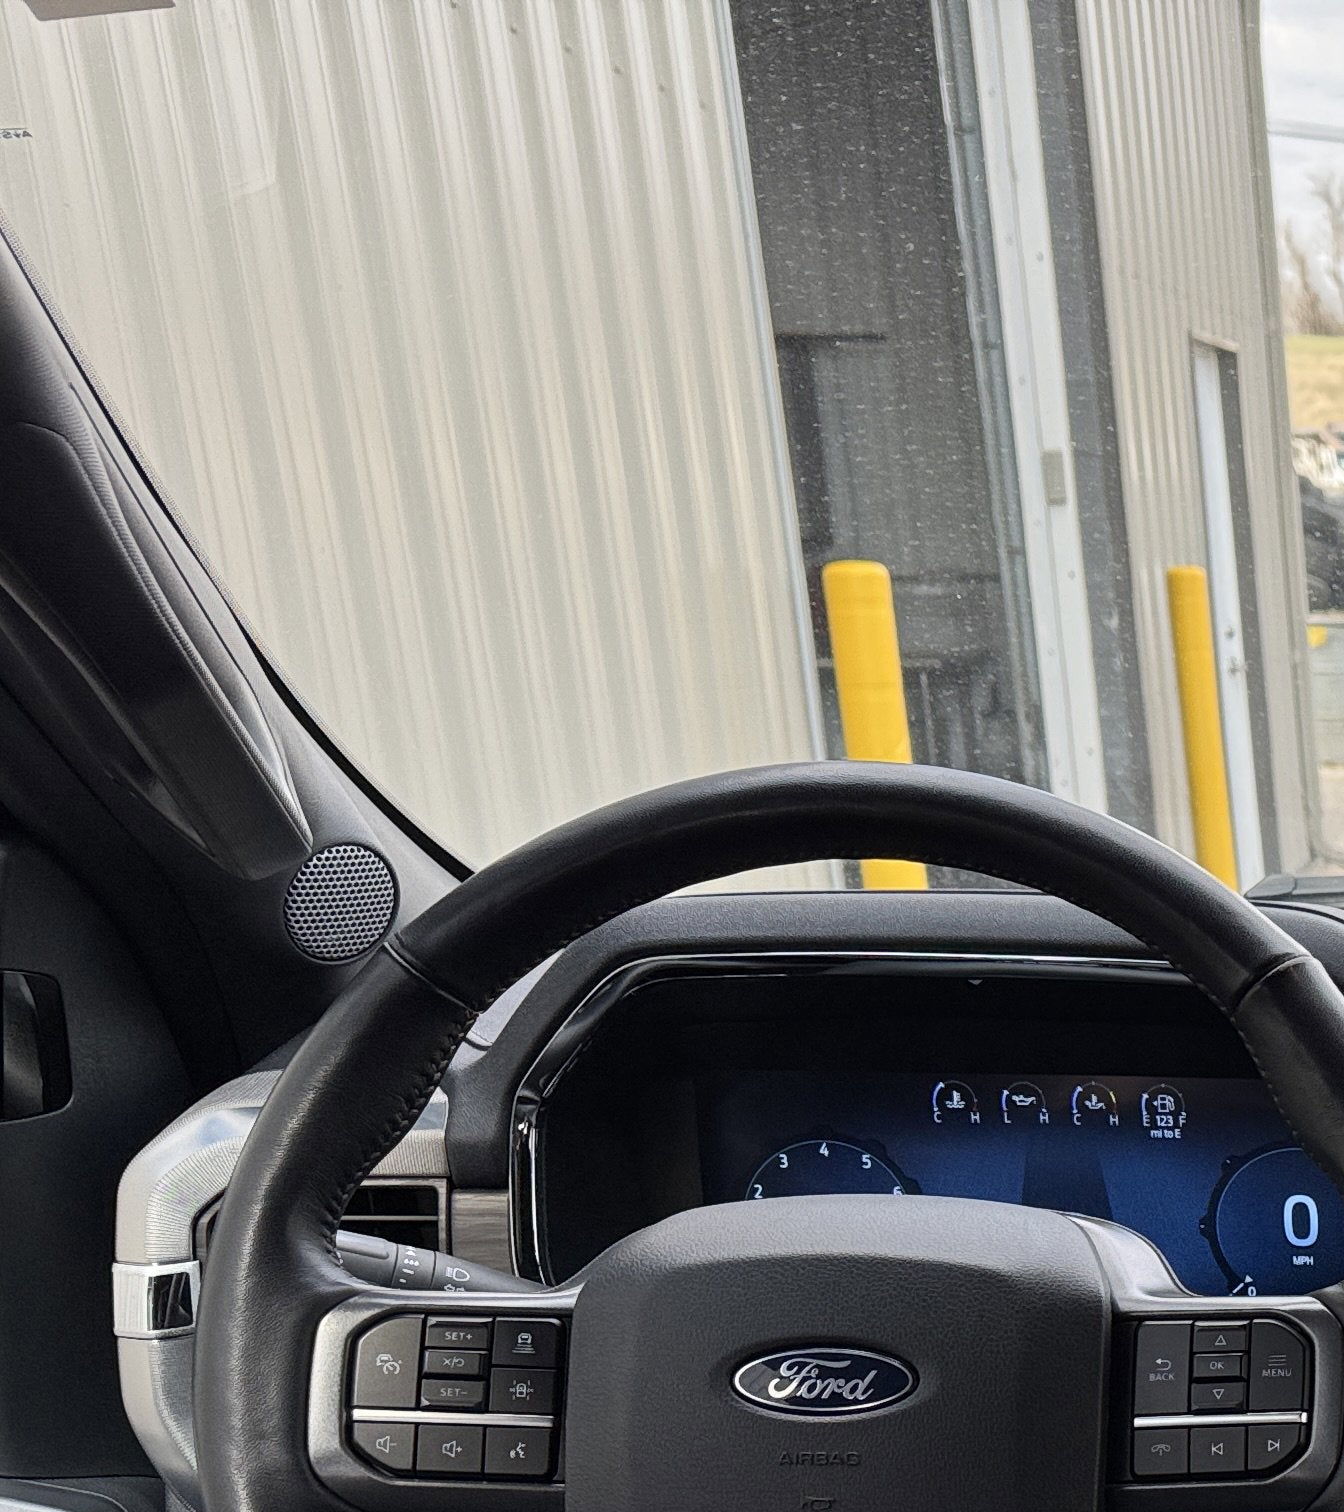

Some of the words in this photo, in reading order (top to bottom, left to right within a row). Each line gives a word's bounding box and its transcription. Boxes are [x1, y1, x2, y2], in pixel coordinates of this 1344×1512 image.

[933, 1112, 942, 1123] C
[970, 1112, 980, 1124] H
[1004, 1112, 1011, 1123] L
[1073, 1114, 1082, 1125] C
[1110, 1114, 1119, 1126] H
[1142, 1115, 1150, 1126] E
[1156, 1115, 1174, 1126] 123
[1179, 1115, 1187, 1127] F
[1164, 1129, 1174, 1138] to
[1175, 1129, 1182, 1138] E
[820, 1142, 829, 1157] 4
[779, 1154, 788, 1169] 3
[862, 1155, 872, 1169] 5
[753, 1185, 763, 1199] 2
[1283, 1194, 1319, 1247] 0
[1293, 1256, 1314, 1266] MPH
[1210, 1361, 1225, 1370] OK
[1149, 1373, 1175, 1382] BACK
[1262, 1368, 1292, 1377] MENU
[768, 1357, 878, 1401] Ford
[779, 1451, 862, 1467] AIRBAG
